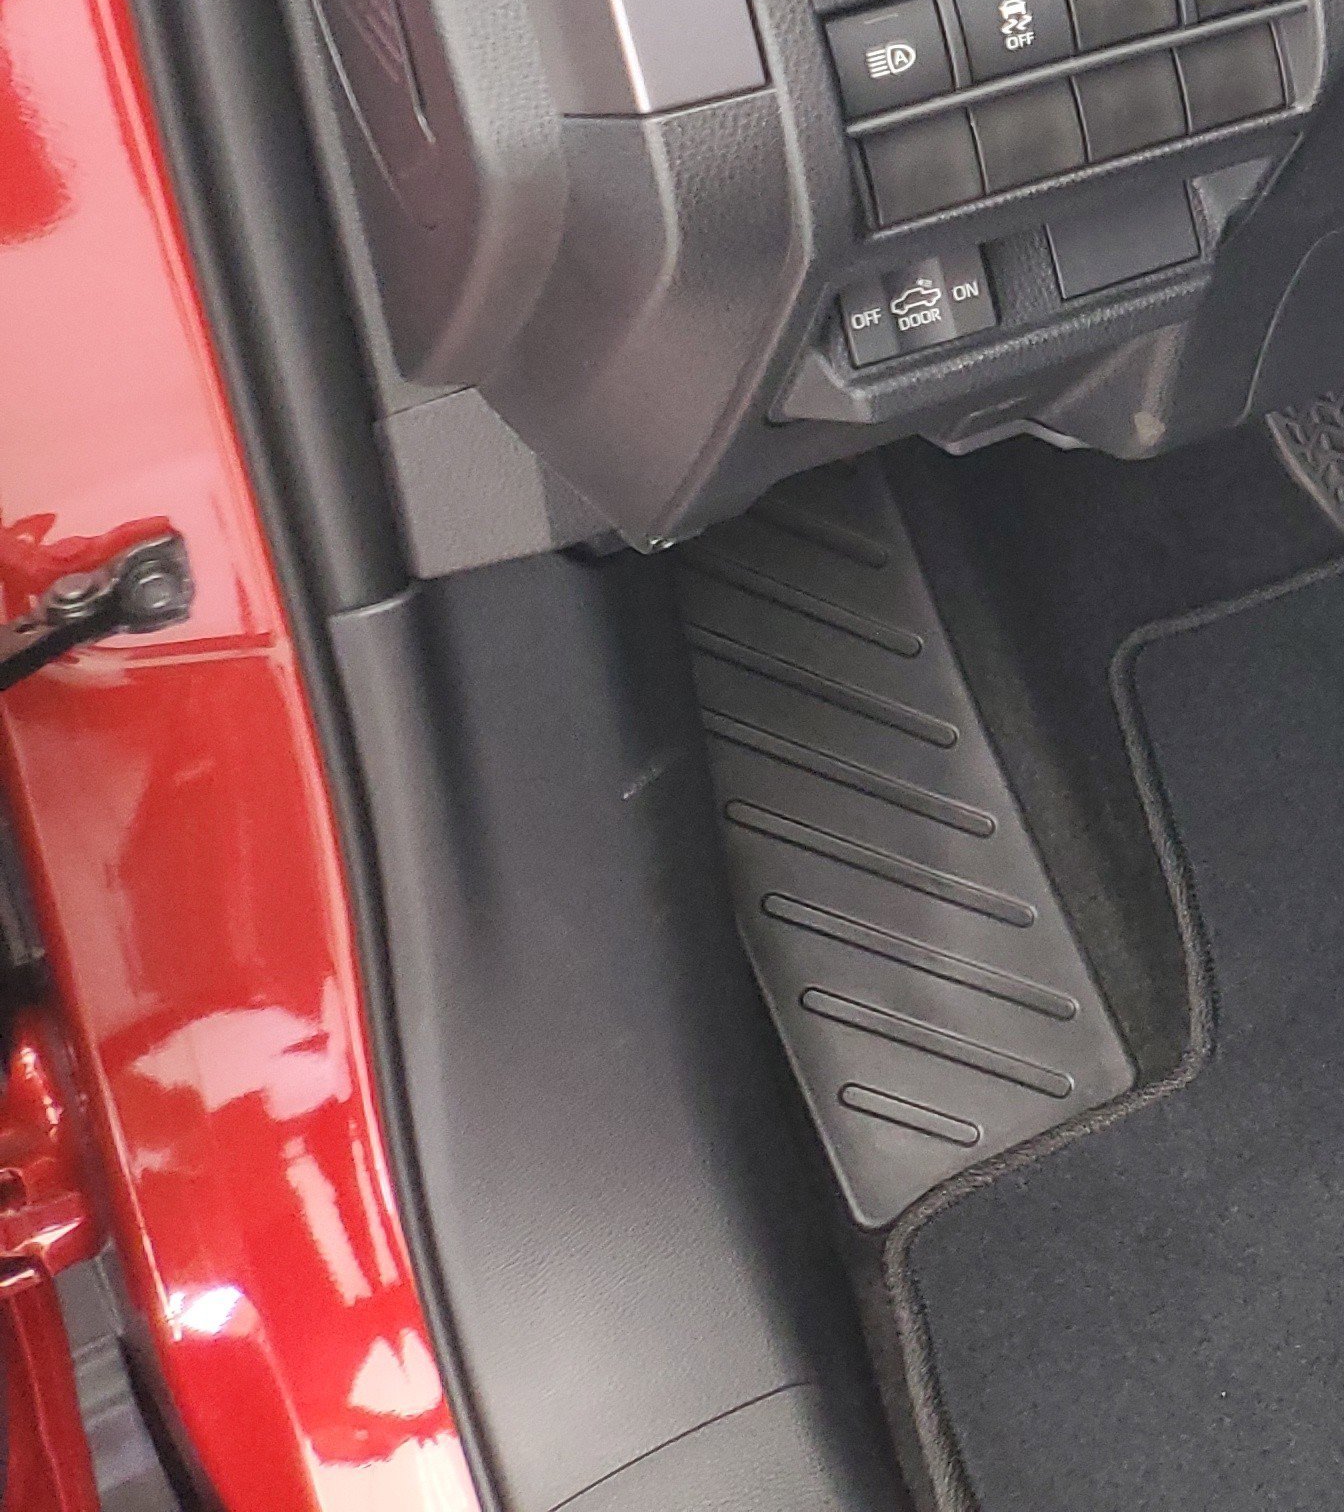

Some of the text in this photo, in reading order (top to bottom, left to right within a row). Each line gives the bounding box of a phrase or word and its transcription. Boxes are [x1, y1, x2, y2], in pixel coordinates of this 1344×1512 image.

[1005, 32, 1034, 50] OFF
[951, 280, 979, 301] ON
[851, 307, 881, 329] OFF
[898, 308, 941, 331] DOOR
